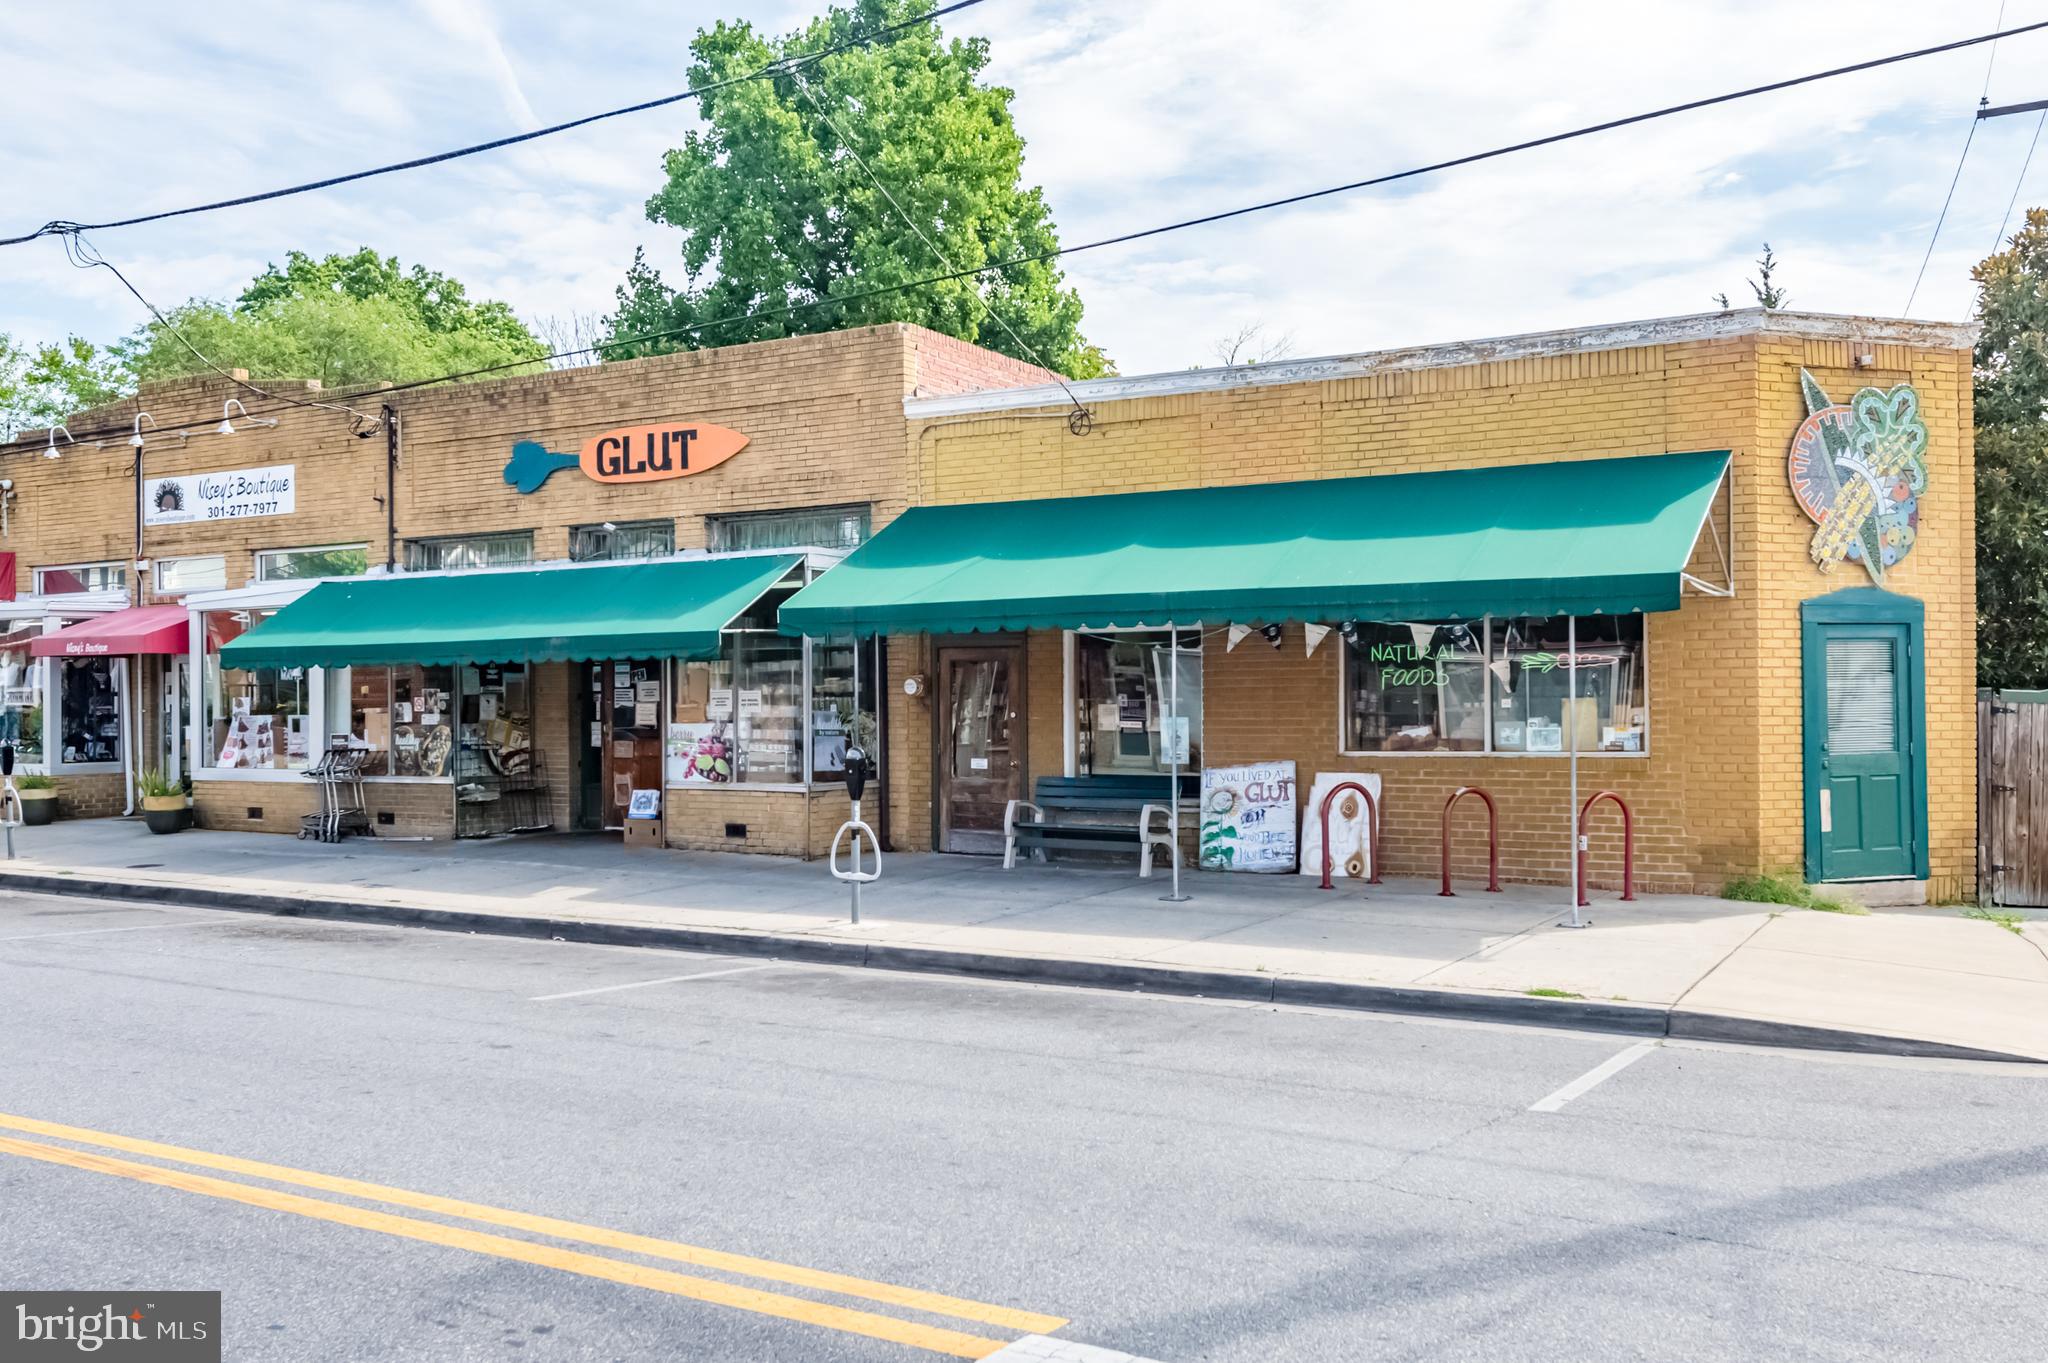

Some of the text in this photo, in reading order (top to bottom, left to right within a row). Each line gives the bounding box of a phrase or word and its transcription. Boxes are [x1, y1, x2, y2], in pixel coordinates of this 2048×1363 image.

[596, 429, 698, 477] GLUT
[198, 472, 290, 504] Nisey's Boutique
[207, 501, 279, 519] 301-277-7977
[85, 642, 109, 653] Boutique
[1370, 643, 1464, 663] NATURAL
[1381, 668, 1450, 690] FOODS
[1204, 772, 1216, 789] IF
[1218, 772, 1240, 784] YOU
[1242, 770, 1272, 782] LIVED
[1244, 780, 1295, 803] GLUT
